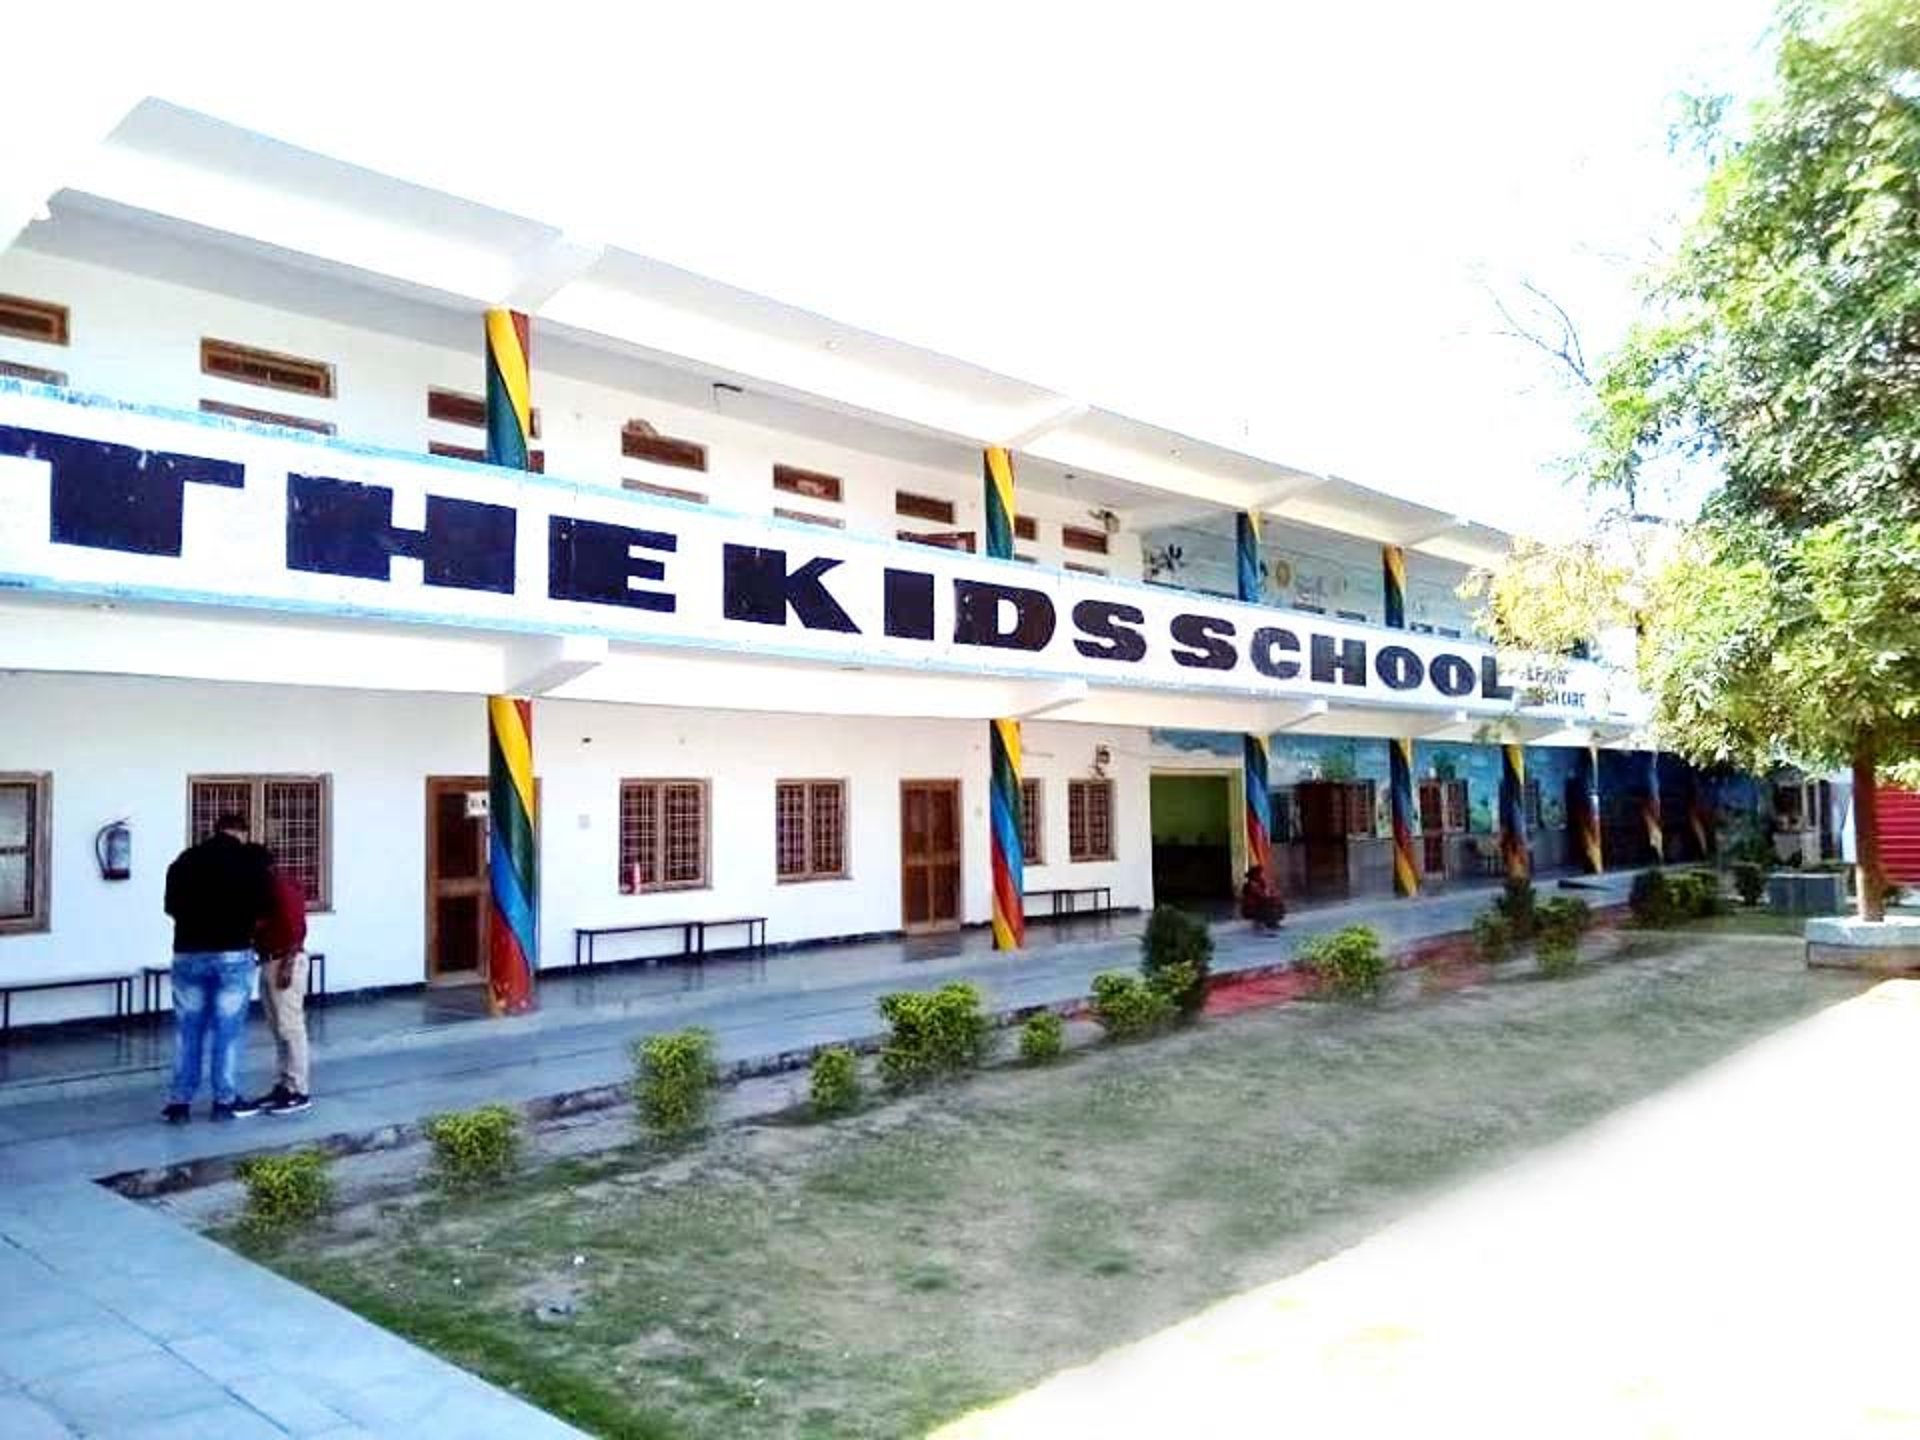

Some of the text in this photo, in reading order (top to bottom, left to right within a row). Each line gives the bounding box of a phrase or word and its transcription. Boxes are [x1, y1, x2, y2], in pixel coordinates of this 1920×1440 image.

[0, 423, 1515, 699] THE KIDS SCHOOL
